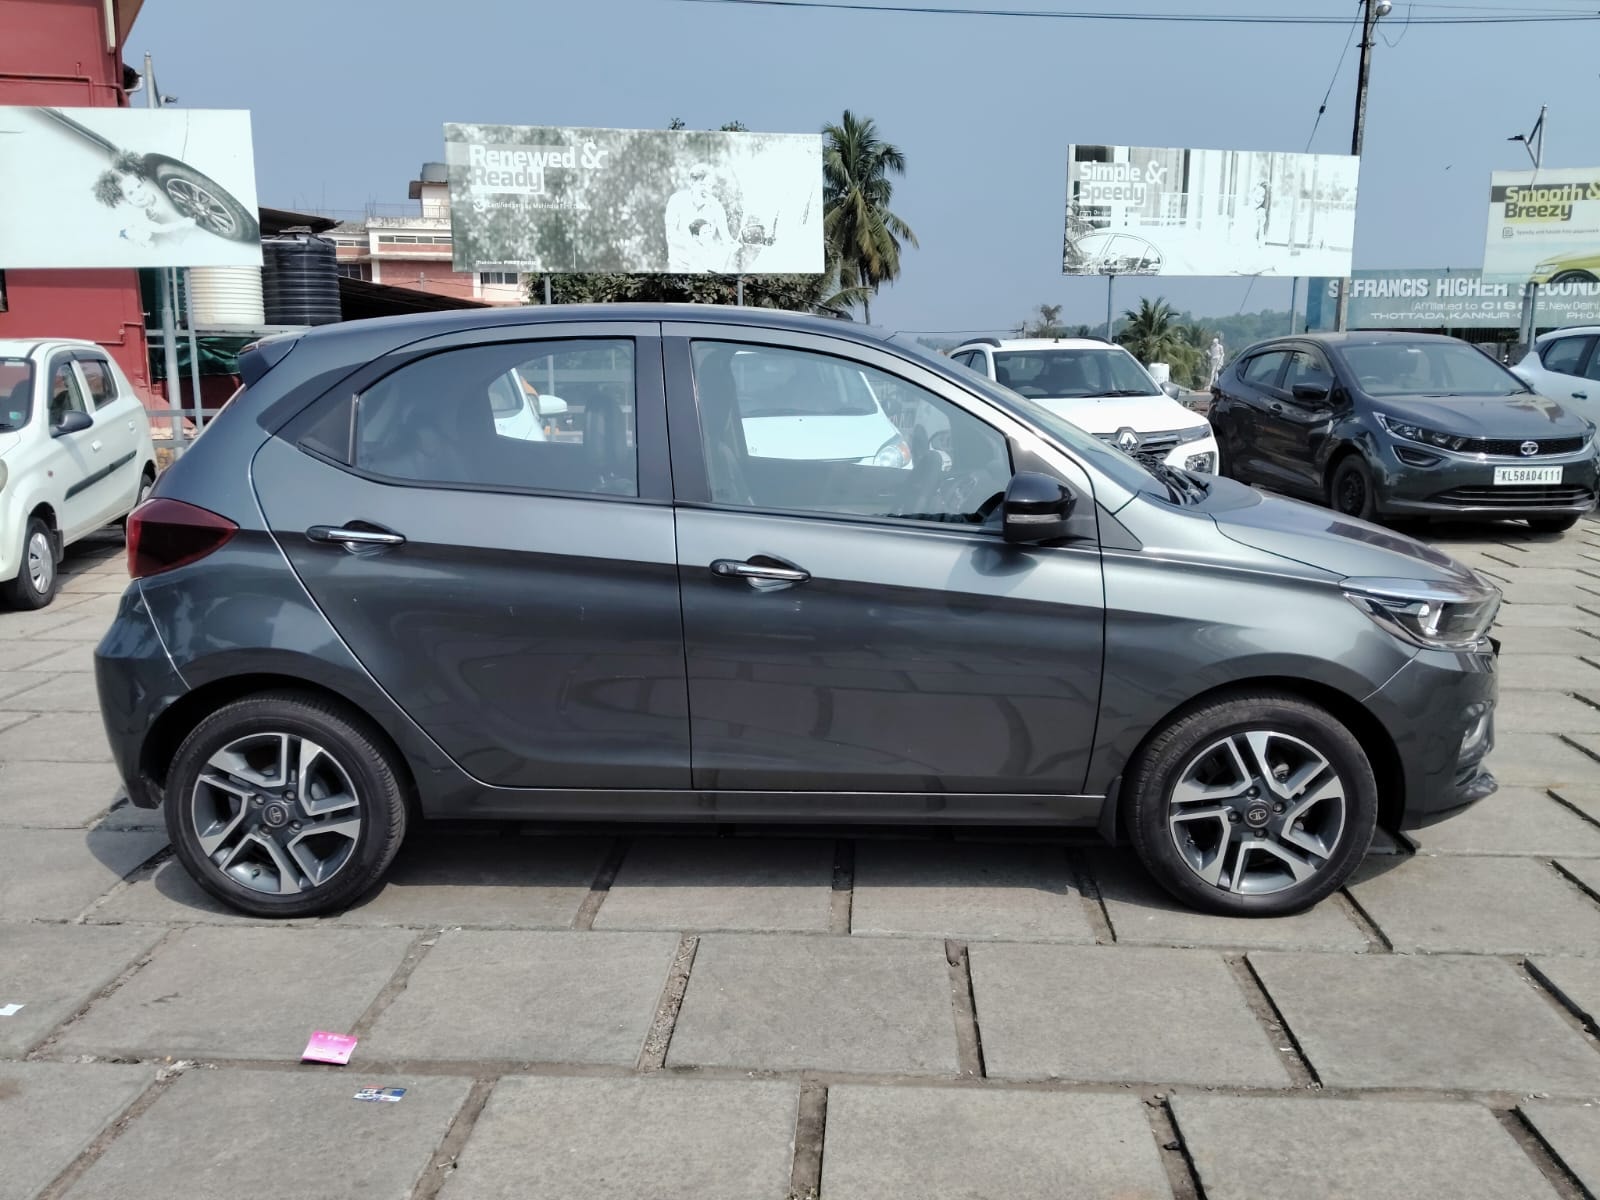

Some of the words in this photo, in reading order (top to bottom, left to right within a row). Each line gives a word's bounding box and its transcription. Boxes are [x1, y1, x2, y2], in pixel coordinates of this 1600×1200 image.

[469, 143, 576, 169] Renewed
[580, 140, 609, 169] &
[471, 165, 541, 193] Ready
[1080, 160, 1141, 183] Simple
[1145, 160, 1168, 185] &
[1079, 181, 1145, 206] Speedy
[1505, 183, 1584, 203] Smooth
[1585, 179, 1600, 201] &
[1504, 202, 1574, 221] Breezy
[1328, 279, 1430, 298] S.FRANCIS
[1436, 278, 1508, 297] HIGHER
[1465, 301, 1478, 311] to
[1501, 470, 1560, 481] KL58AD4111
